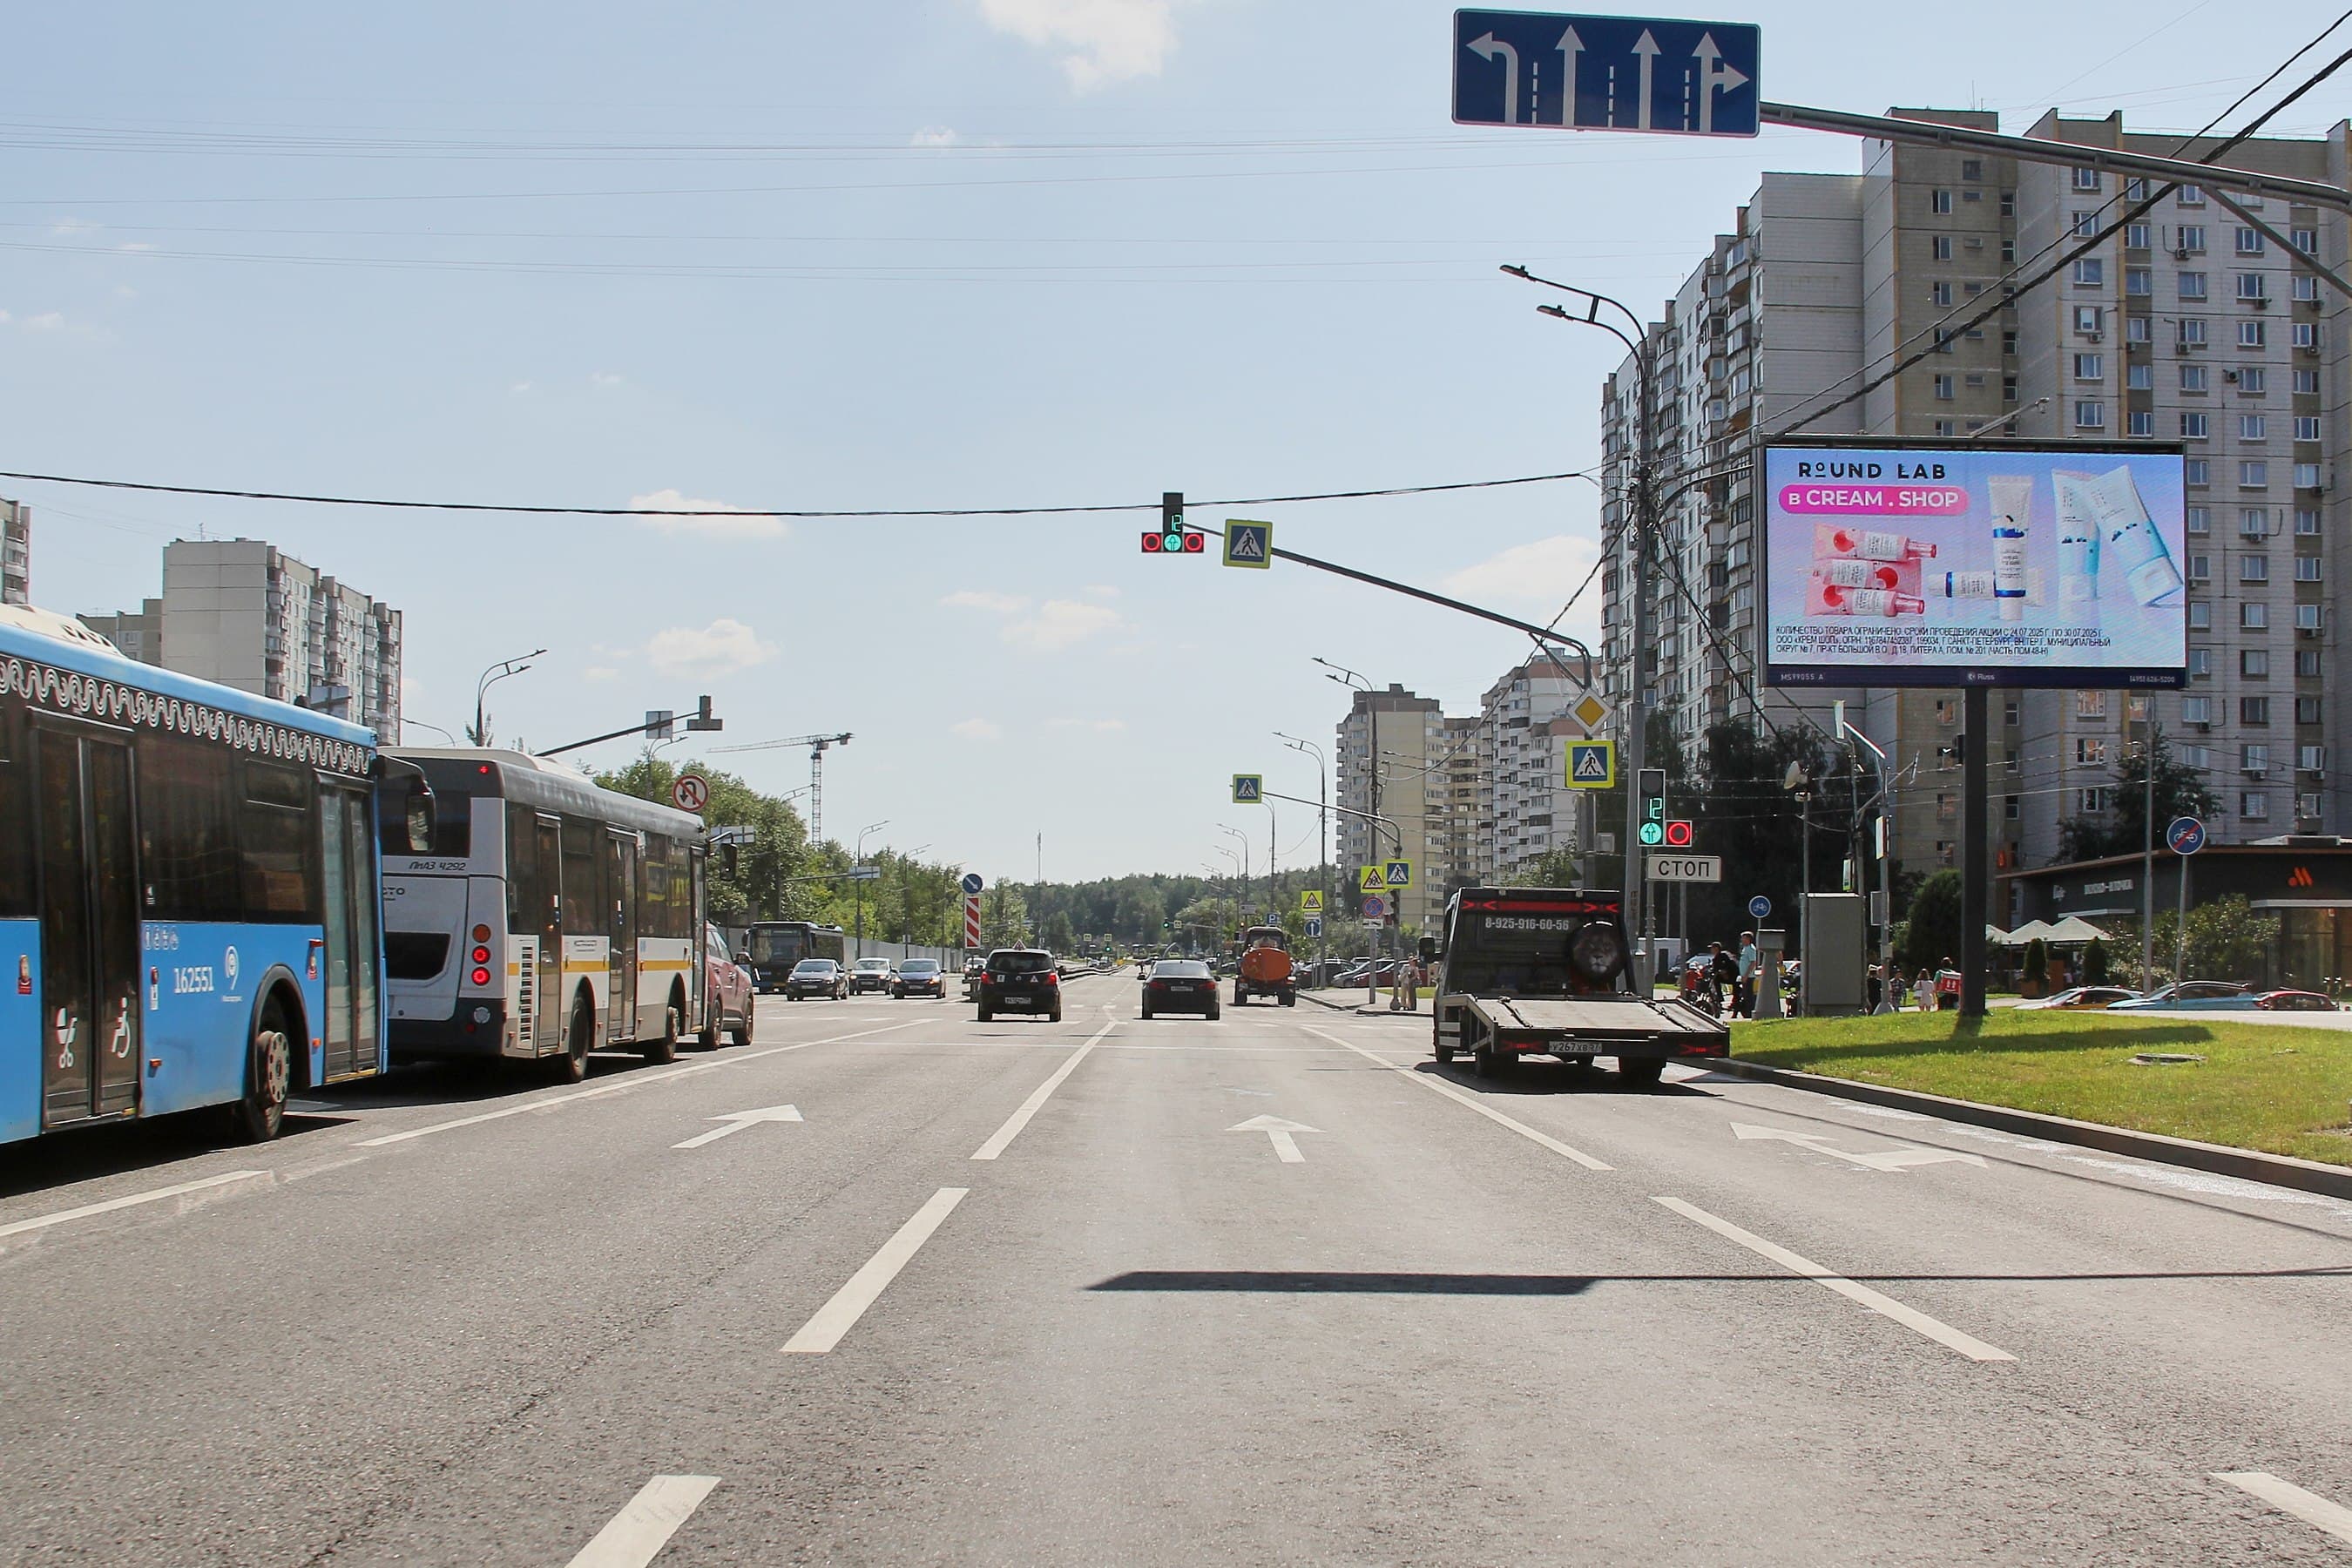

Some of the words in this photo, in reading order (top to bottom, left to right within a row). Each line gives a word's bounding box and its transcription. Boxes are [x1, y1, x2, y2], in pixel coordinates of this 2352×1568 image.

[1798, 462, 1882, 479] ROUND
[1897, 463, 1946, 479] LAB
[1898, 490, 1959, 507] SHOP
[1776, 625, 1824, 635] КОЛИЧЕСТВО
[1825, 626, 1854, 635] ТОВАРА
[1904, 627, 1928, 636] СРОКИ
[1930, 627, 1977, 636] ПРОВЕДЕНИЯ
[1978, 628, 2002, 637] АКЦИИ
[1776, 635, 1794, 644] ООО
[2048, 638, 2111, 646] МУНИЦИПАЛЬНЫЙ
[1776, 644, 1799, 653] ОКРУГ
[1838, 645, 1874, 654] БОЛЬШОЙ
[1649, 798, 1663, 819] 12
[439, 862, 466, 871] 4292
[1659, 861, 1710, 877] СТОП
[1485, 917, 1570, 930] 8-925-916-60-56
[174, 966, 214, 994] 162551
